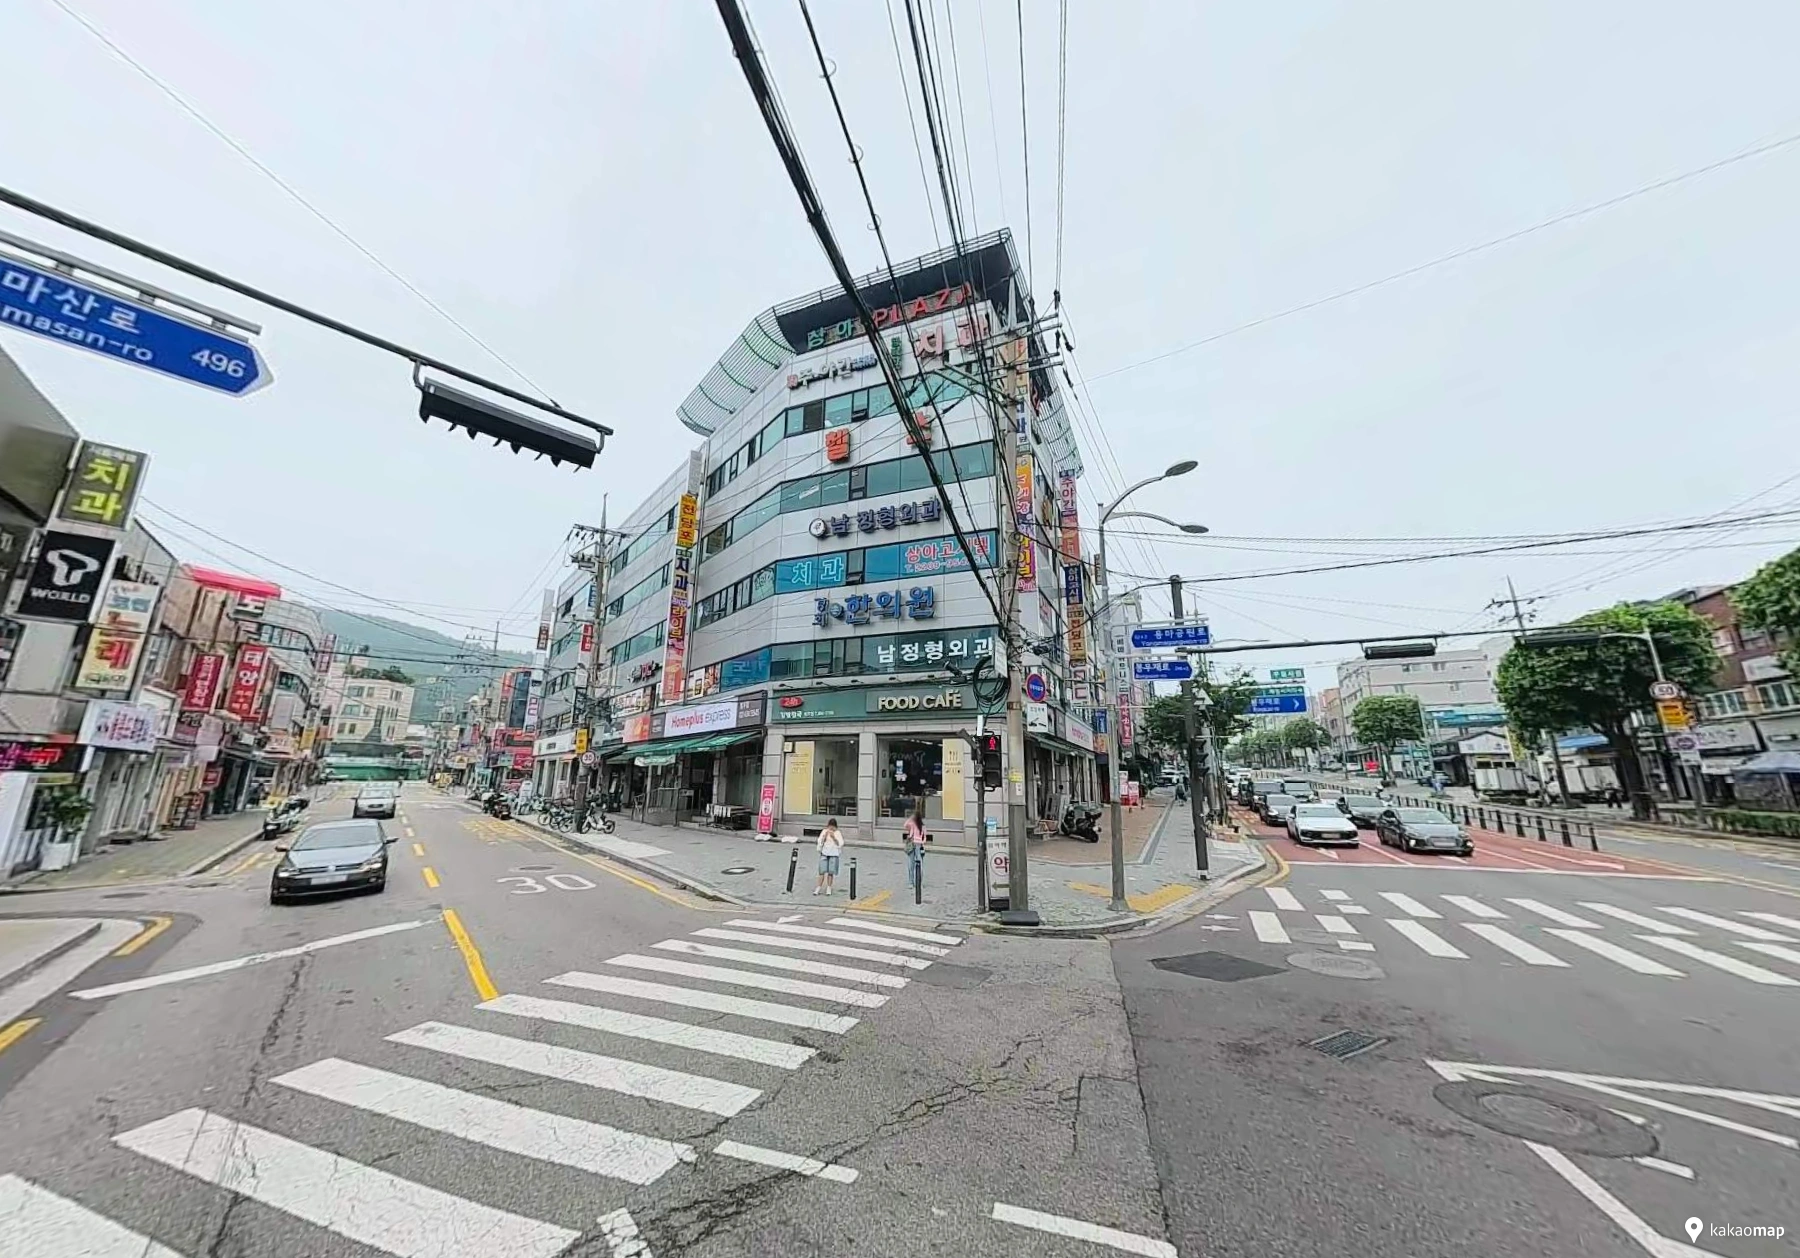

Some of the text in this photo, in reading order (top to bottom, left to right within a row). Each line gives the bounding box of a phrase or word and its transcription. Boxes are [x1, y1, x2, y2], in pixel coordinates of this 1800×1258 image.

[2, 269, 141, 335] 마산로
[1, 304, 154, 362] masan-ro
[190, 348, 246, 379] 496
[71, 457, 132, 522] 치과
[674, 557, 690, 591] 치과
[791, 556, 845, 586] 치과
[844, 585, 934, 625] 한의원
[877, 694, 920, 711] FOOD
[671, 710, 704, 729] Homeplus
[496, 873, 597, 895] 30
